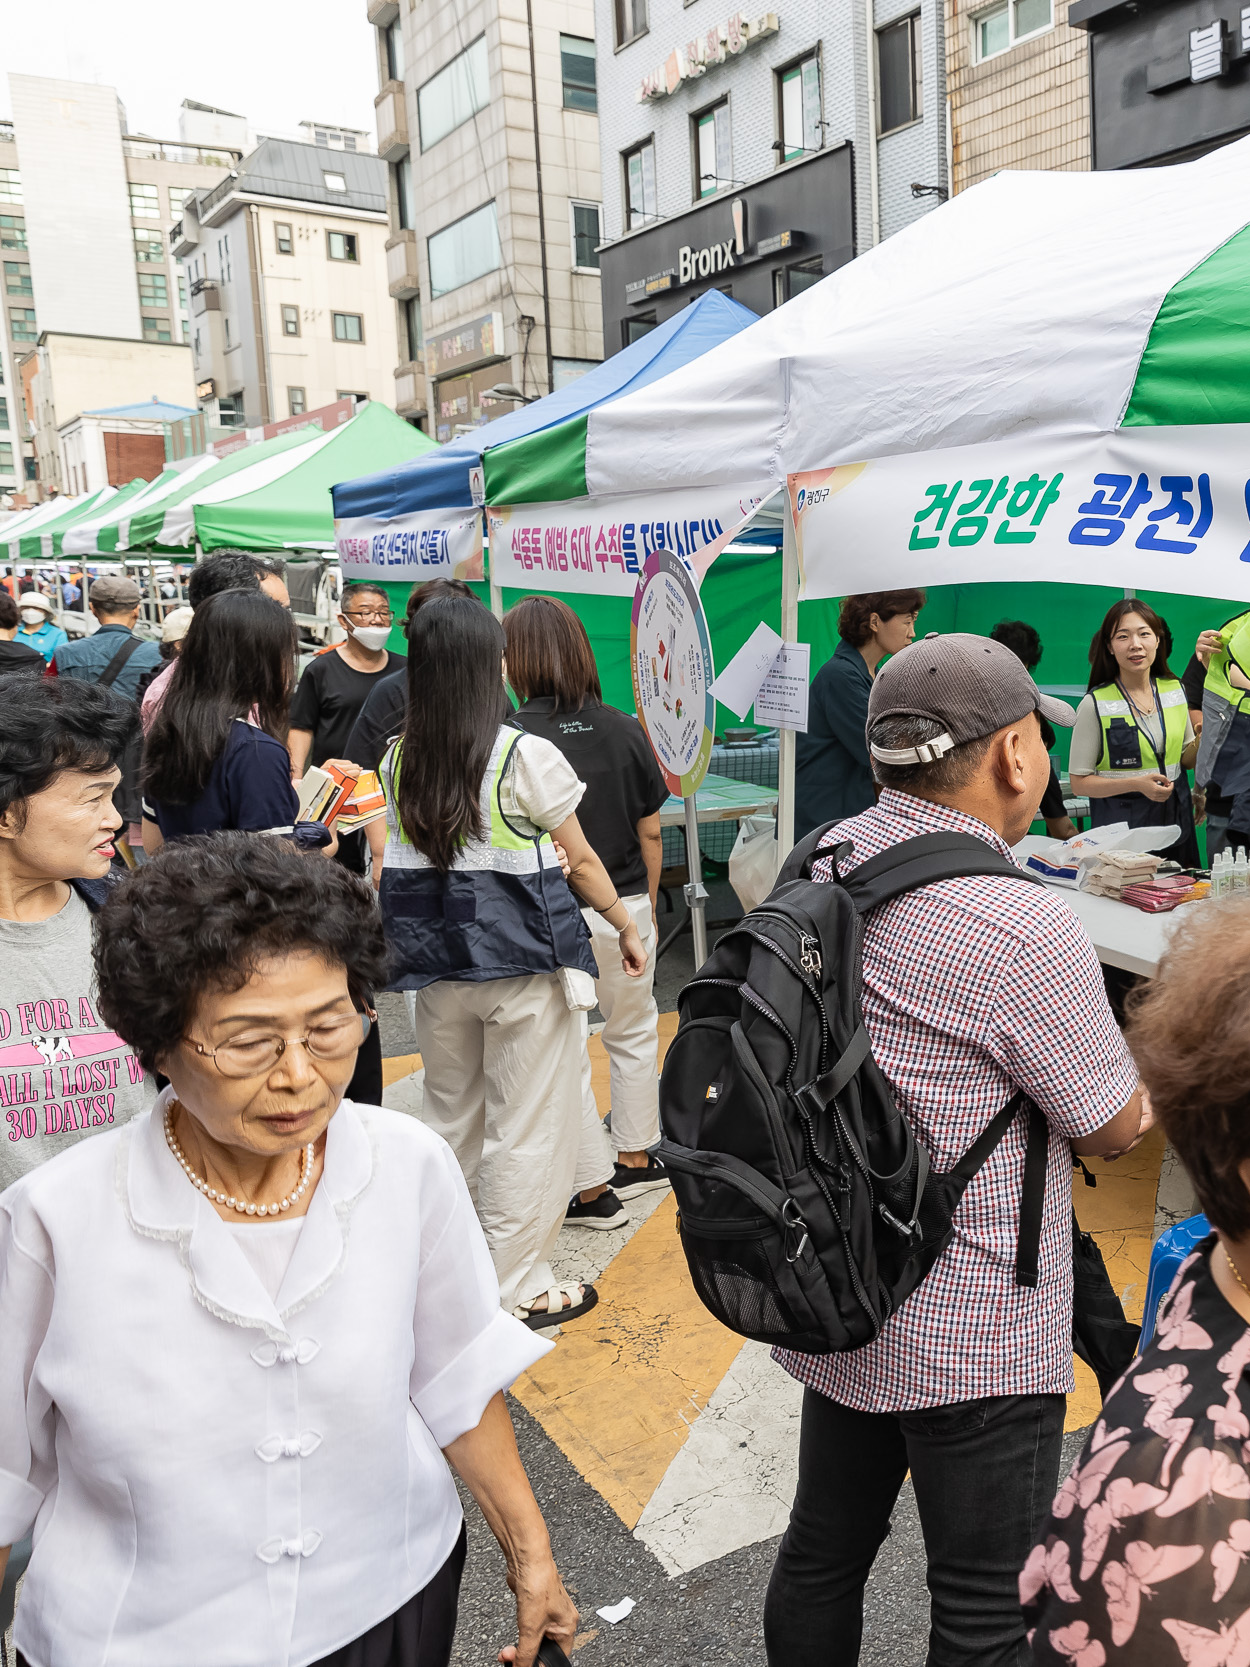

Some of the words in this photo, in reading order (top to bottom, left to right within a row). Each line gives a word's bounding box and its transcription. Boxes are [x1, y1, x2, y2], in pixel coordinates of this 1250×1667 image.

[679, 238, 735, 284] Bronx
[806, 487, 831, 505] 광진구
[908, 471, 1065, 552] 건강한
[1068, 472, 1214, 555] 광진
[420, 529, 450, 565] 만들기
[511, 527, 545, 571] 식중독
[545, 526, 568, 572] 예방
[570, 524, 593, 573] 6대
[594, 523, 640, 574] 수칙을
[18, 998, 72, 1036] FOR
[78, 996, 97, 1029] A
[0, 1070, 39, 1108] ALL
[44, 1067, 54, 1101] I
[59, 1057, 121, 1098] LOST
[6, 1105, 37, 1143] 30
[44, 1093, 117, 1137] DAYS!
